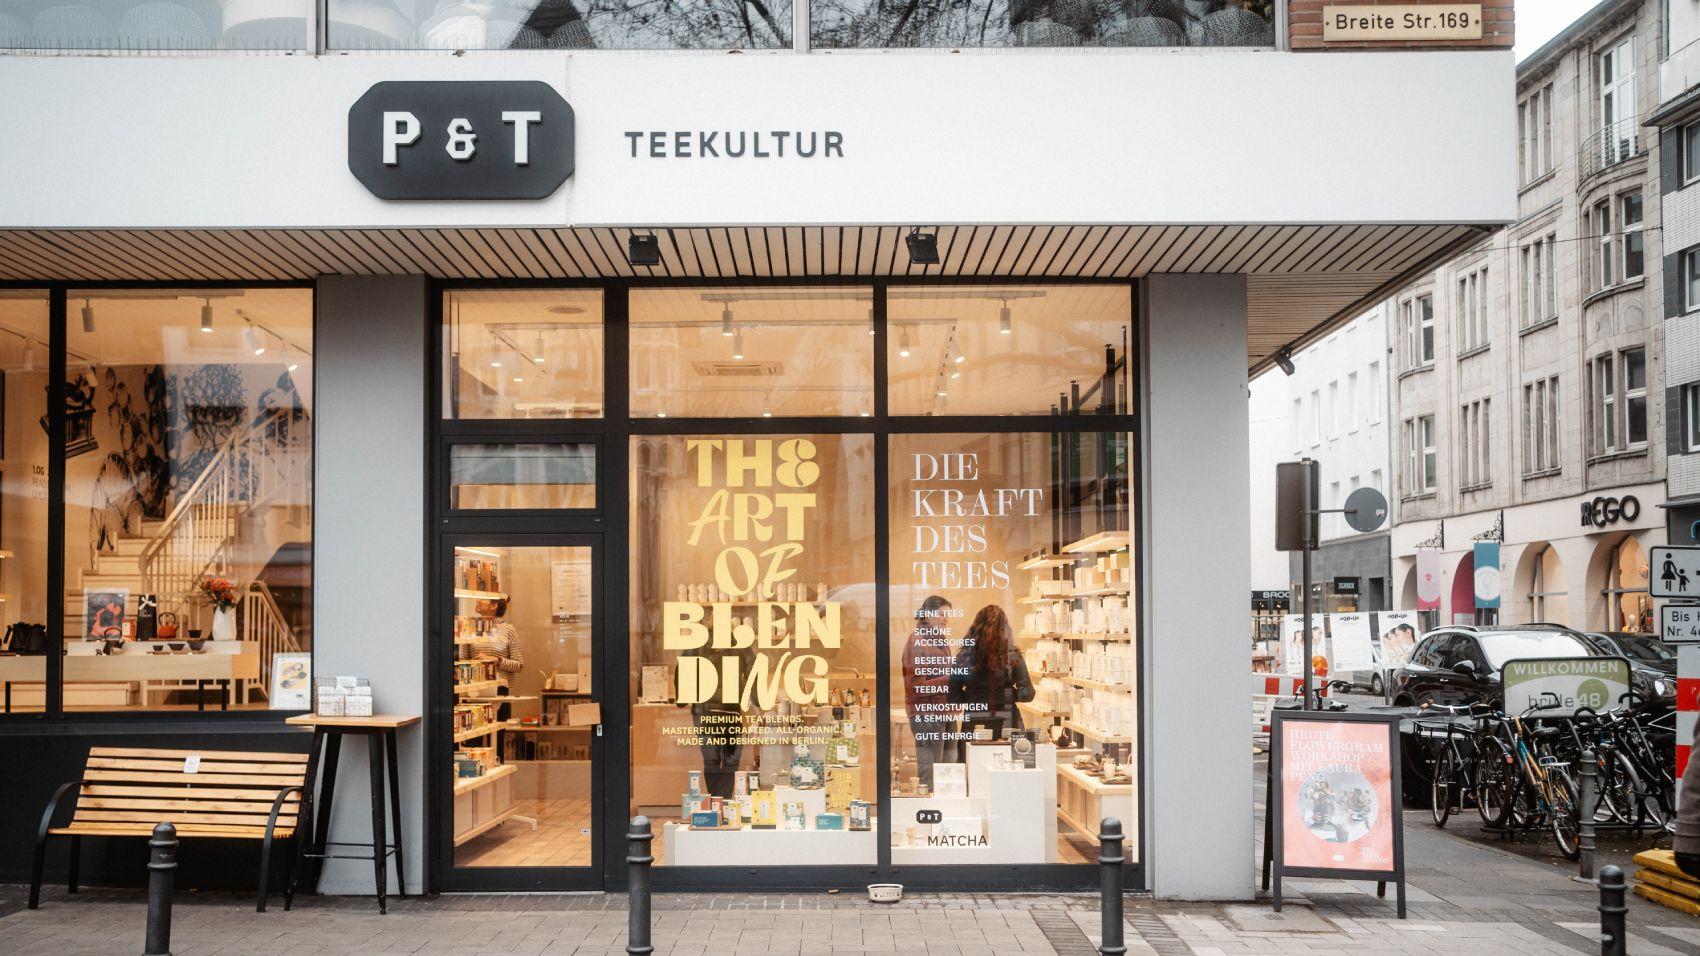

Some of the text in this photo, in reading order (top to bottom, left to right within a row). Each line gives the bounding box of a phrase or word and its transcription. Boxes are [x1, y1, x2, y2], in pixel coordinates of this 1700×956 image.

[1336, 14, 1394, 29] Breite
[382, 110, 542, 166] P & T
[624, 131, 845, 158] TEEKULTUR
[687, 438, 820, 487] THE
[910, 453, 979, 481] DIE
[912, 488, 1043, 517] KRAFT
[687, 488, 817, 546] ART
[912, 524, 987, 553] DES
[714, 542, 804, 598] OF
[912, 560, 1010, 589] TEES
[914, 609, 965, 618] FEINE TEES
[1672, 610, 1690, 622] Bis
[663, 602, 841, 649] BLEN
[914, 626, 952, 636] SCHÖNE
[1667, 626, 1684, 637] Nr.
[914, 638, 976, 647] ACCESSOIRES
[914, 656, 957, 665] BESEELTE
[914, 667, 969, 676] GESCHENKE
[1513, 661, 1619, 675] WILLKOMMEN
[676, 651, 829, 712] DING
[914, 685, 949, 694] TEEBAR
[914, 703, 988, 712] VERKOSTUNGEN
[700, 715, 805, 724] PREMIUM TEA BLENDS.
[914, 714, 971, 723] & SEMINARE
[662, 726, 726, 735] MASTERFULLY
[915, 732, 981, 741] GUTE ENERGIE
[677, 737, 704, 746] MADE
[706, 737, 727, 746] AND
[729, 737, 777, 745] DESIGNED
[779, 737, 789, 745] IN
[927, 835, 988, 847] MATCHA
